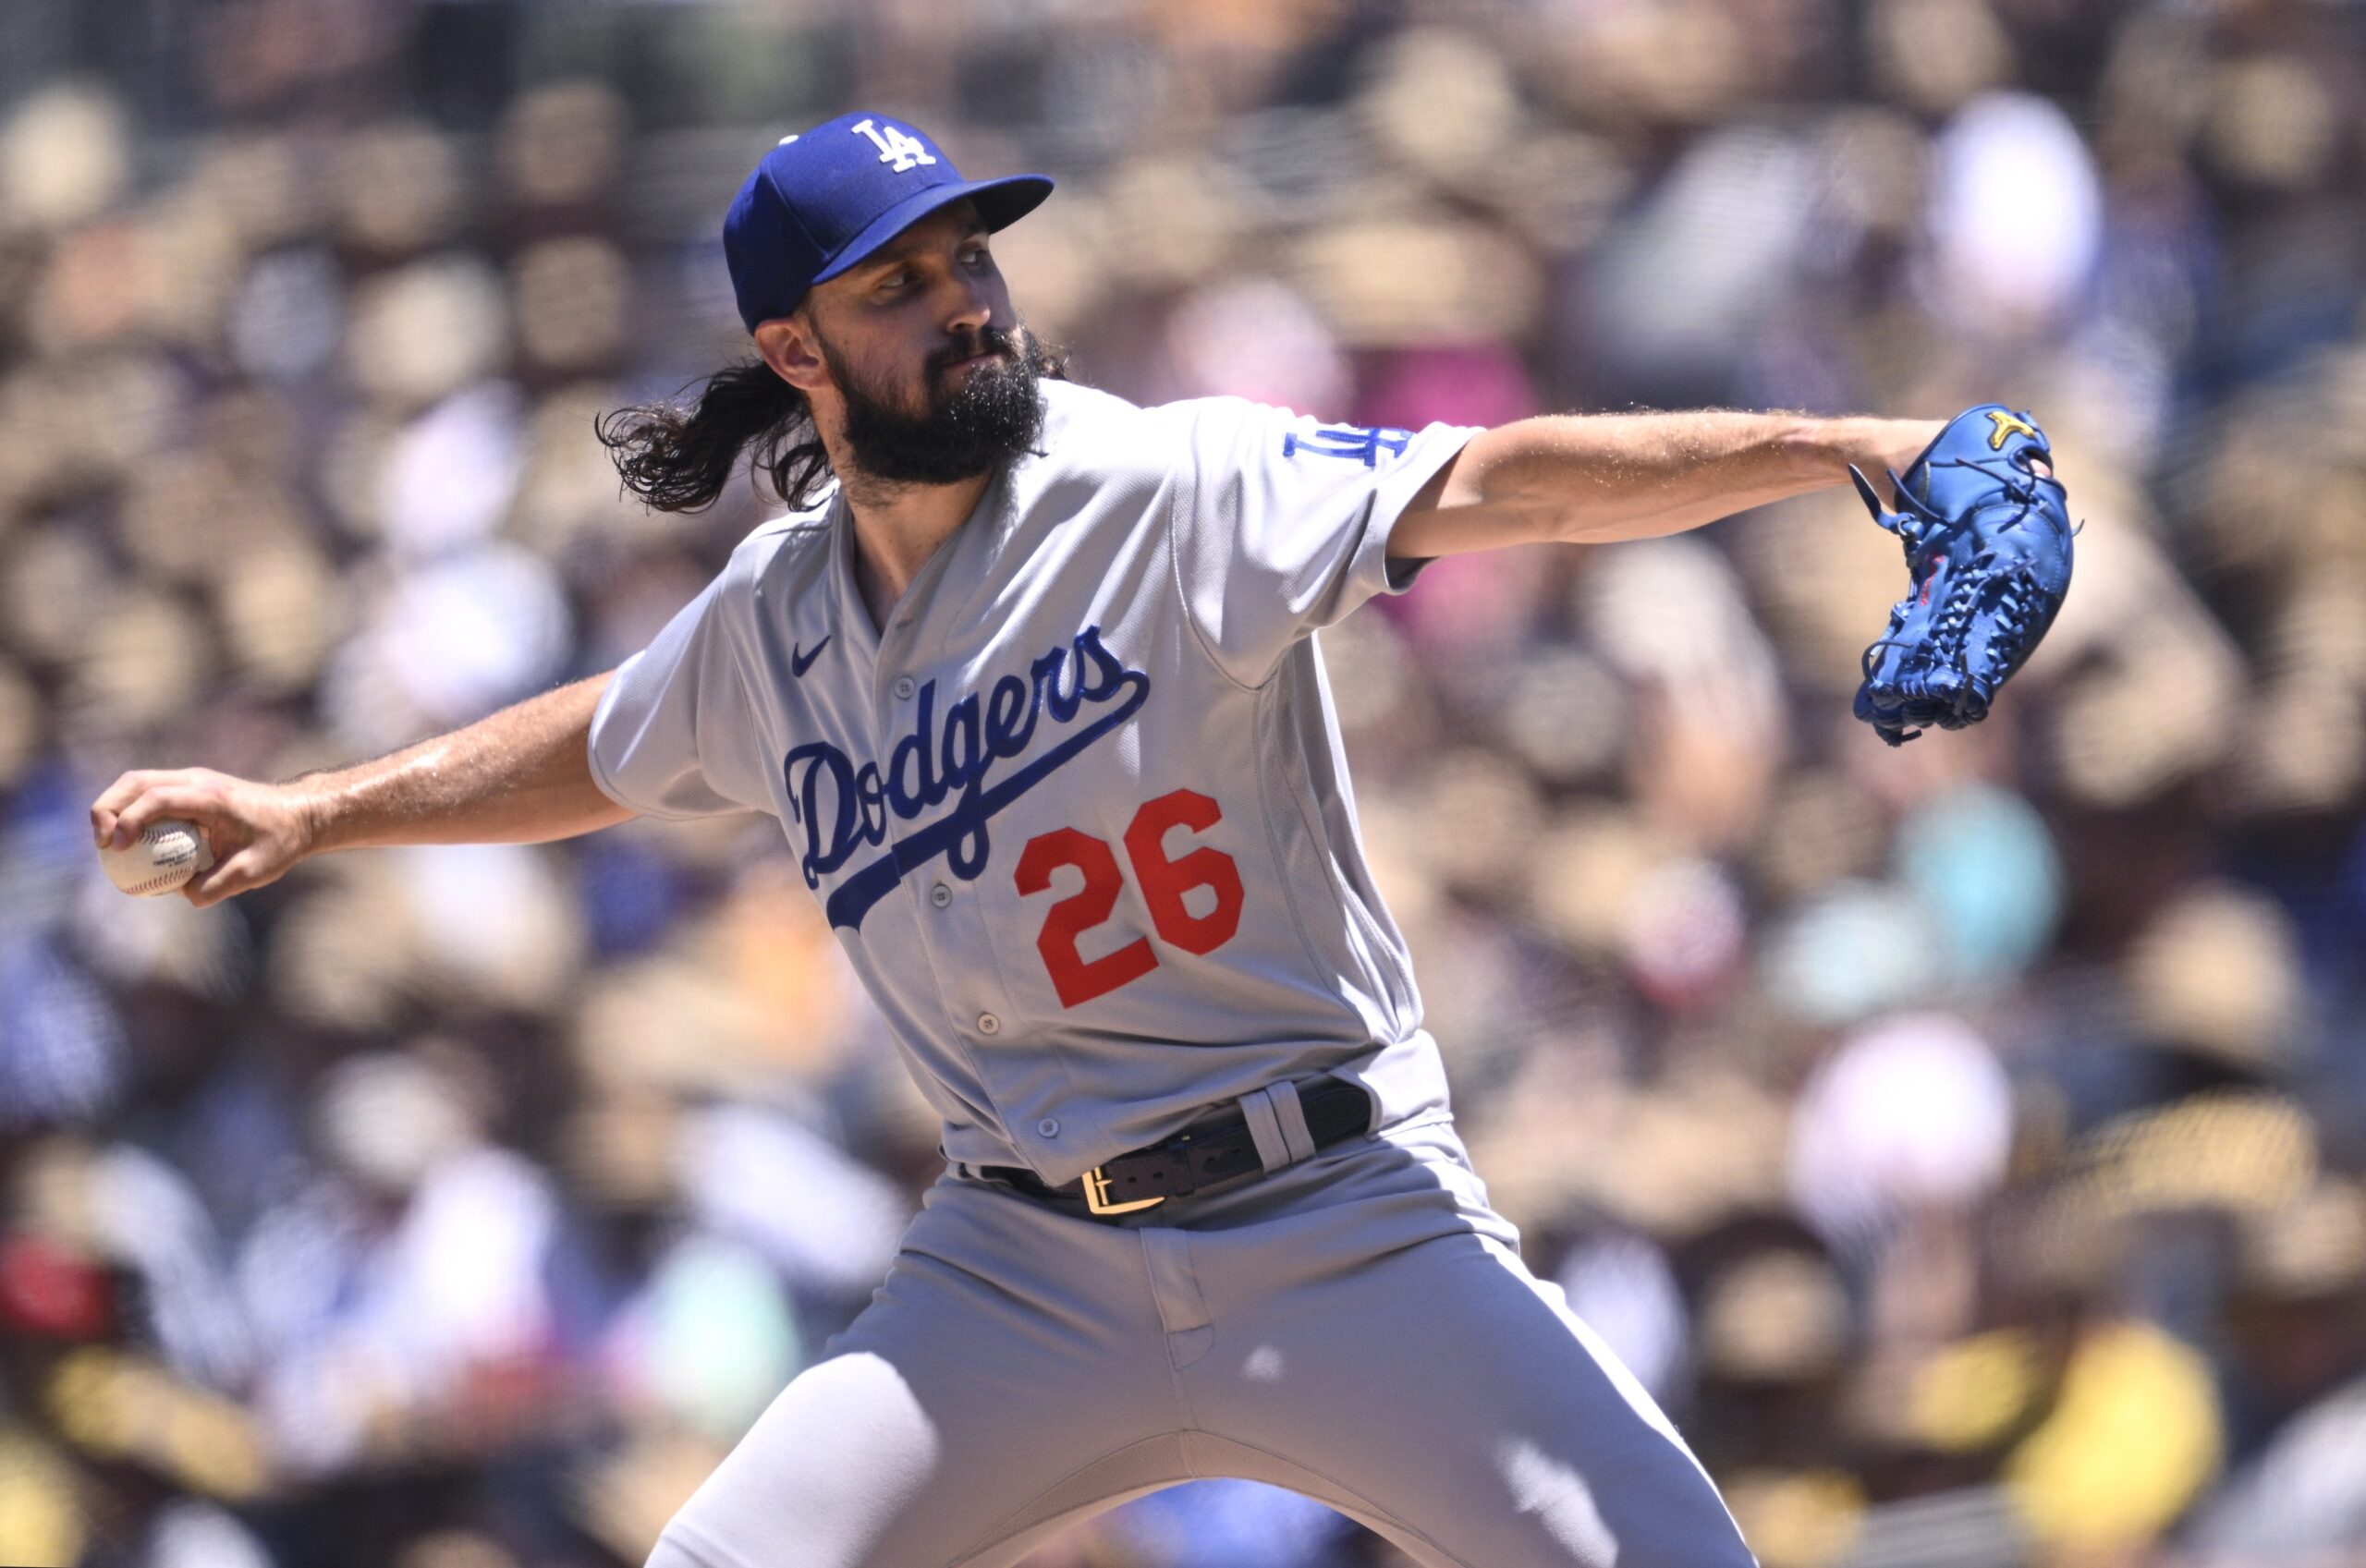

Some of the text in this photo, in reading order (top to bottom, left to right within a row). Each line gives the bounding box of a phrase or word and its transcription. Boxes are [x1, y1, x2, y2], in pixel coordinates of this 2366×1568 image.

[851, 119, 936, 174] LA
[784, 626, 1151, 893] Dodgers
[1014, 788, 1245, 1009] 26
